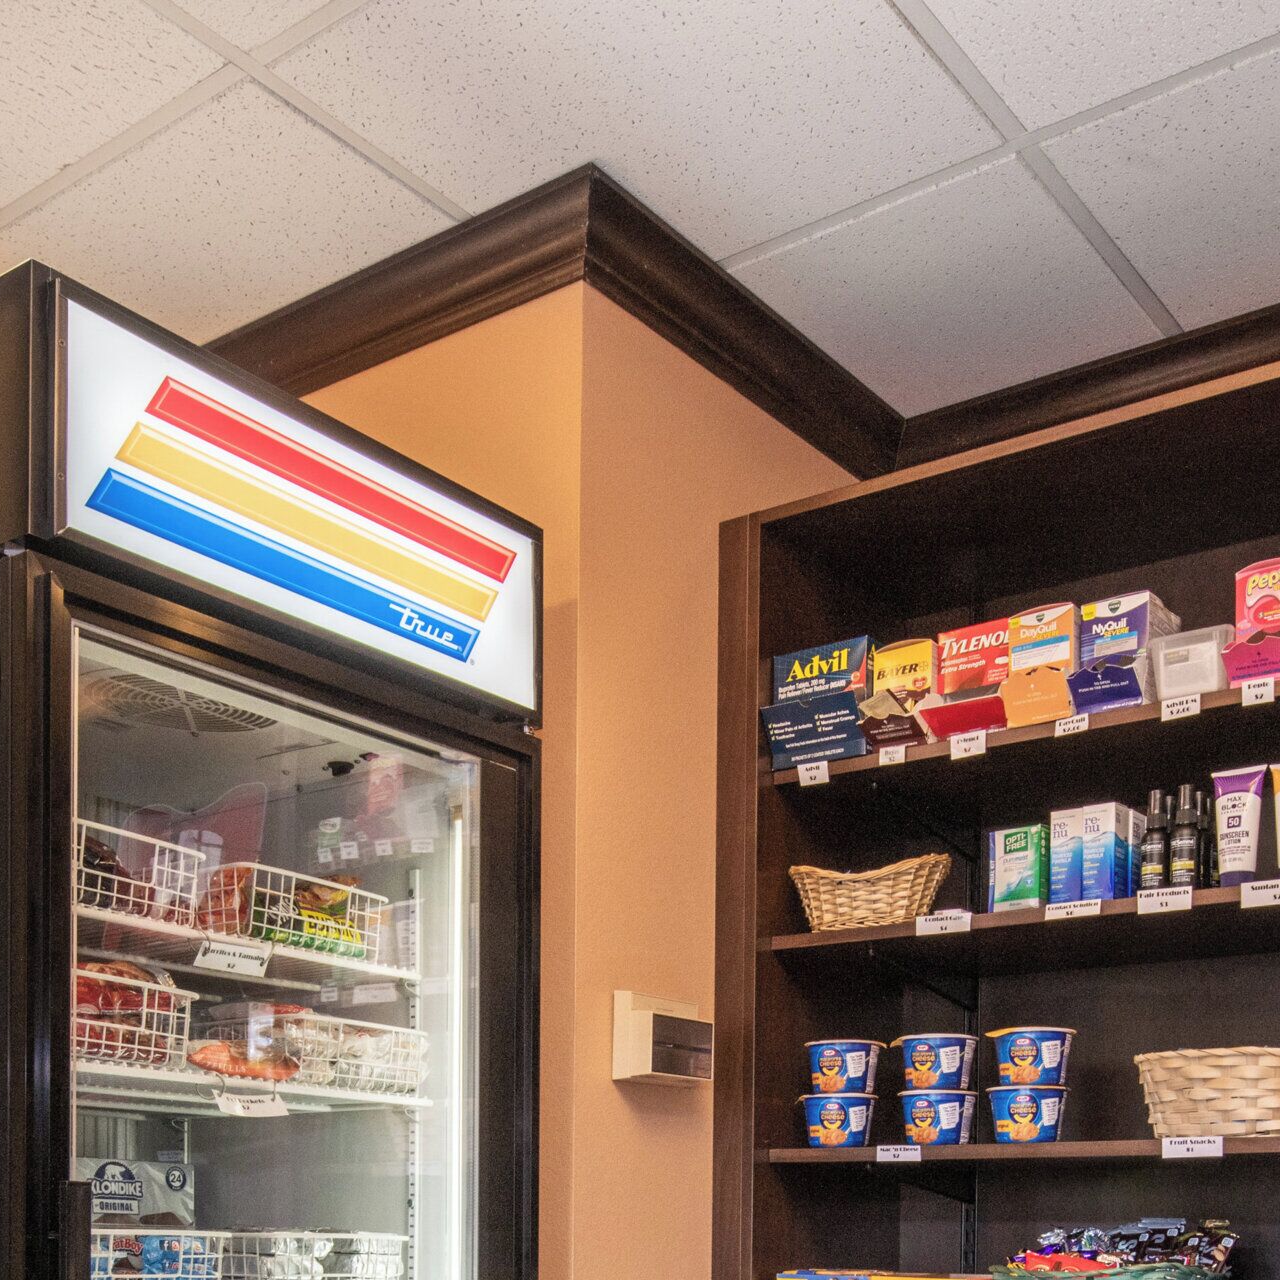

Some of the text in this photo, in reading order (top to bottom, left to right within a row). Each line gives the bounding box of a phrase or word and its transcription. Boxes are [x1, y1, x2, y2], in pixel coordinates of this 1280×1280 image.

[388, 602, 460, 652] true
[1020, 622, 1058, 639] DayQuil
[1092, 617, 1127, 635] NyQuil
[1103, 626, 1130, 637] SEVERE
[785, 648, 850, 683] Advil
[941, 658, 986, 675] Extra Strength
[877, 662, 919, 681] BAYER
[1247, 681, 1270, 690] Pepto
[1221, 802, 1248, 811] BLOCK
[1229, 817, 1240, 827] 50
[1005, 832, 1026, 845] OPTI-
[1219, 830, 1250, 841] SUNSCREEN
[1006, 842, 1028, 852] FREE
[1224, 838, 1242, 846] LOTION
[1251, 882, 1280, 891] Suntan
[1139, 888, 1190, 899] Hair Products
[1047, 901, 1099, 912] Contact Solution
[1169, 1137, 1217, 1146] Fruit Snacks
[170, 1173, 182, 1184] 24
[99, 1201, 134, 1212] ORIGINAL
